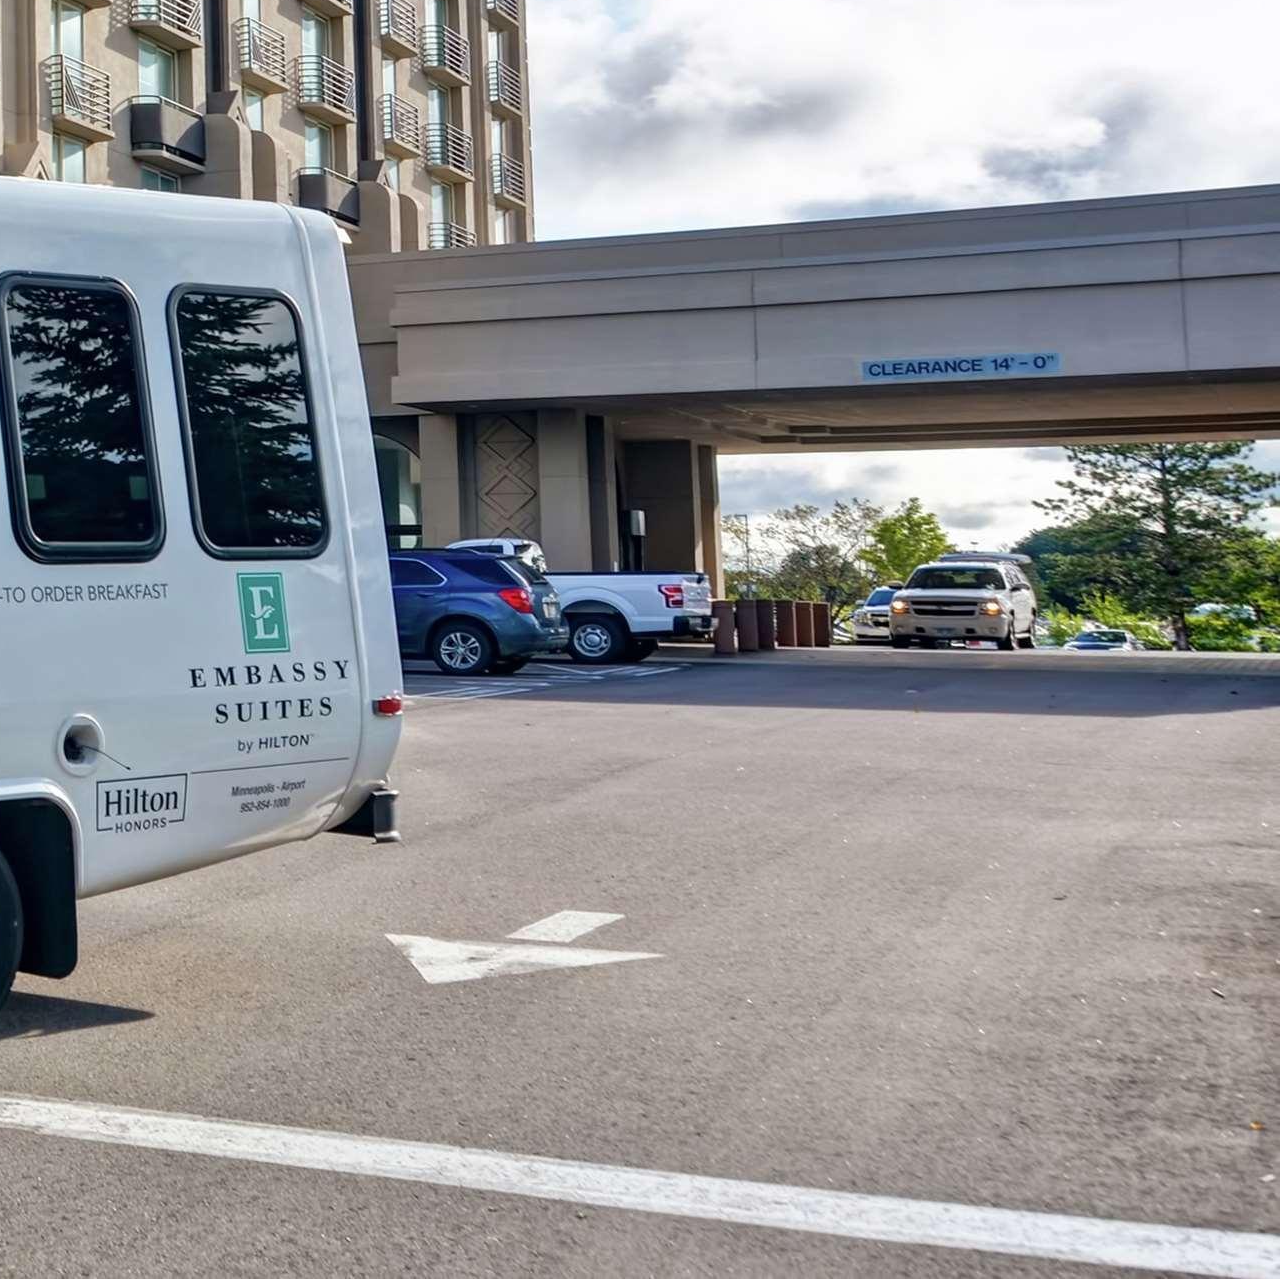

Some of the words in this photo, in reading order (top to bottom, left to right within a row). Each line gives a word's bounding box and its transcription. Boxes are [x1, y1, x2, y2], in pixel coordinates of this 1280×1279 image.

[868, 358, 983, 377] CLEARANCE
[31, 585, 85, 603] ORDER
[87, 583, 169, 602] BREAKFAST
[188, 660, 349, 688] EMBASSY
[215, 697, 333, 724] SUITES
[238, 740, 253, 754] by
[104, 788, 178, 817] Hilton
[115, 817, 168, 833] HONORS
